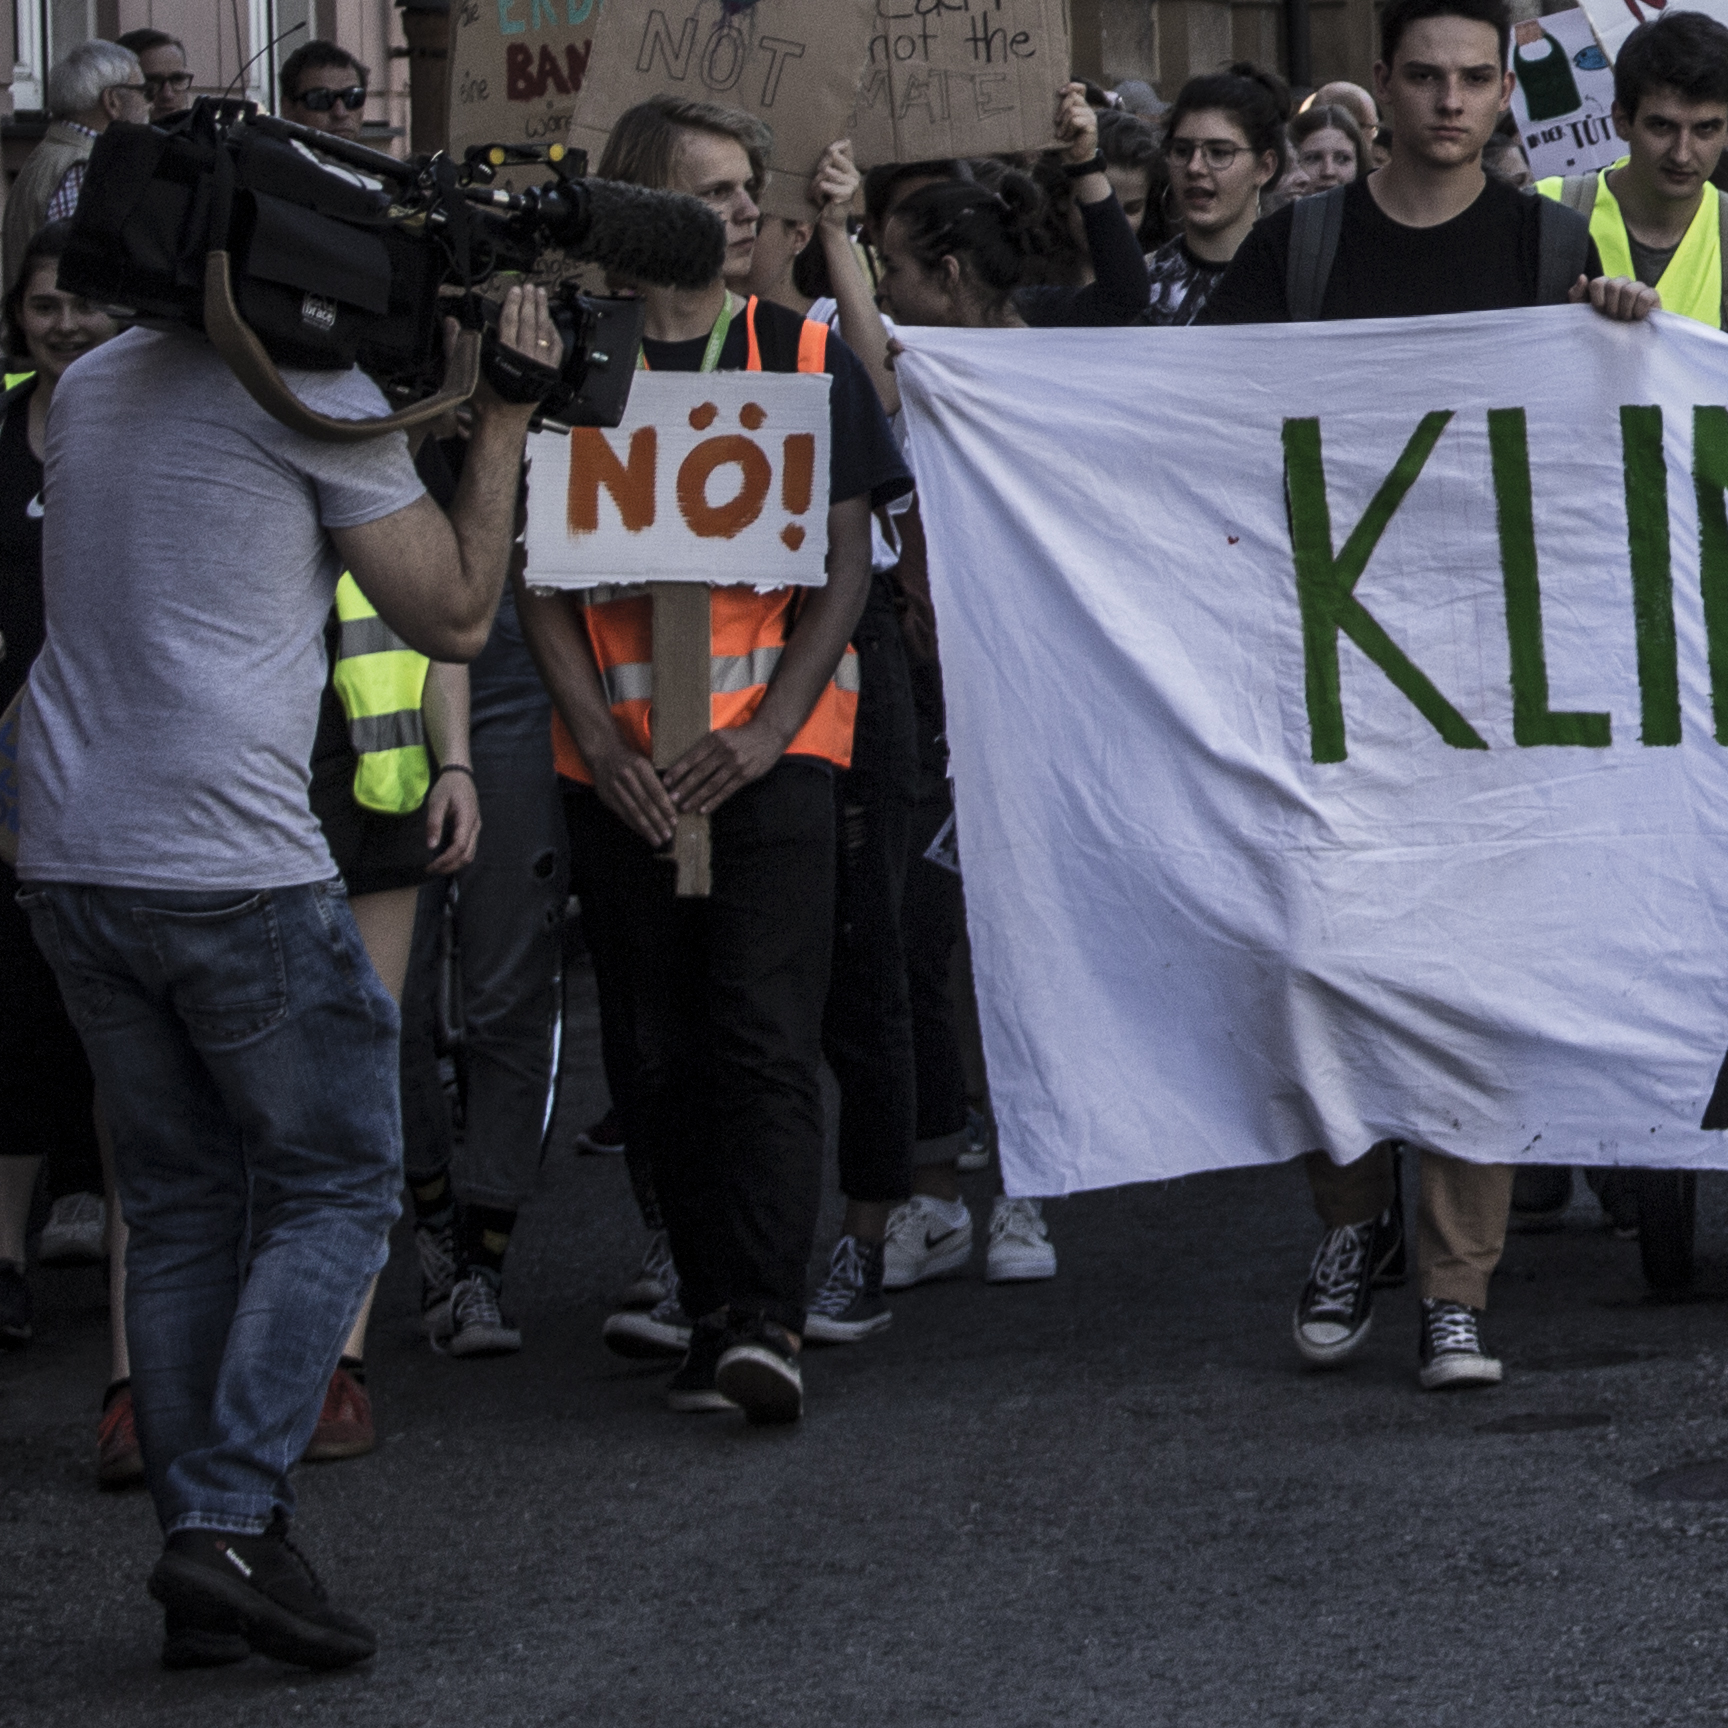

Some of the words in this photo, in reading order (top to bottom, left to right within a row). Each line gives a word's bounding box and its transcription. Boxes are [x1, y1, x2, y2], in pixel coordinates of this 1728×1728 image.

[636, 9, 806, 108] NOT
[868, 14, 938, 64] not
[965, 11, 1037, 62] the
[567, 402, 815, 551] NÖ!
